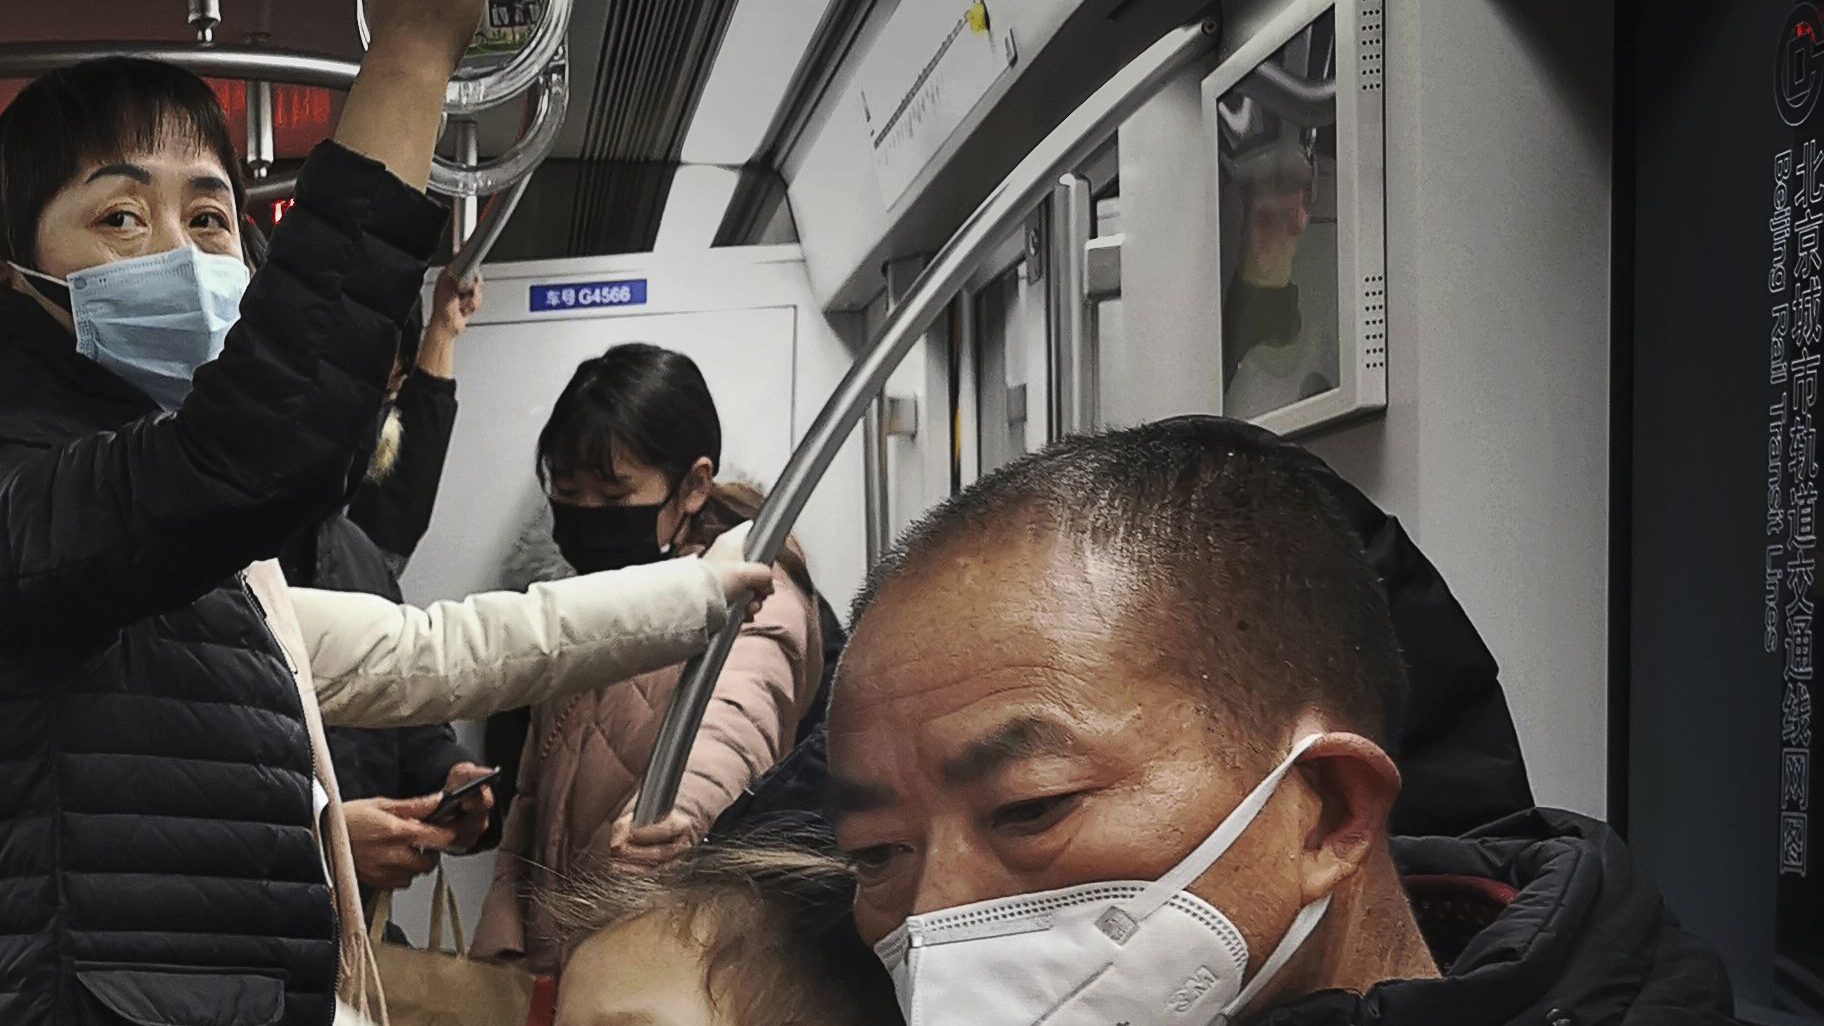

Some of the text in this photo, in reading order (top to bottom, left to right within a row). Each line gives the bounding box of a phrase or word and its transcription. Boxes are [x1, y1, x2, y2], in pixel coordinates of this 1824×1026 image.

[578, 285, 632, 305] G4566
[1764, 149, 1792, 653] Beijing Rail Transit Lines
